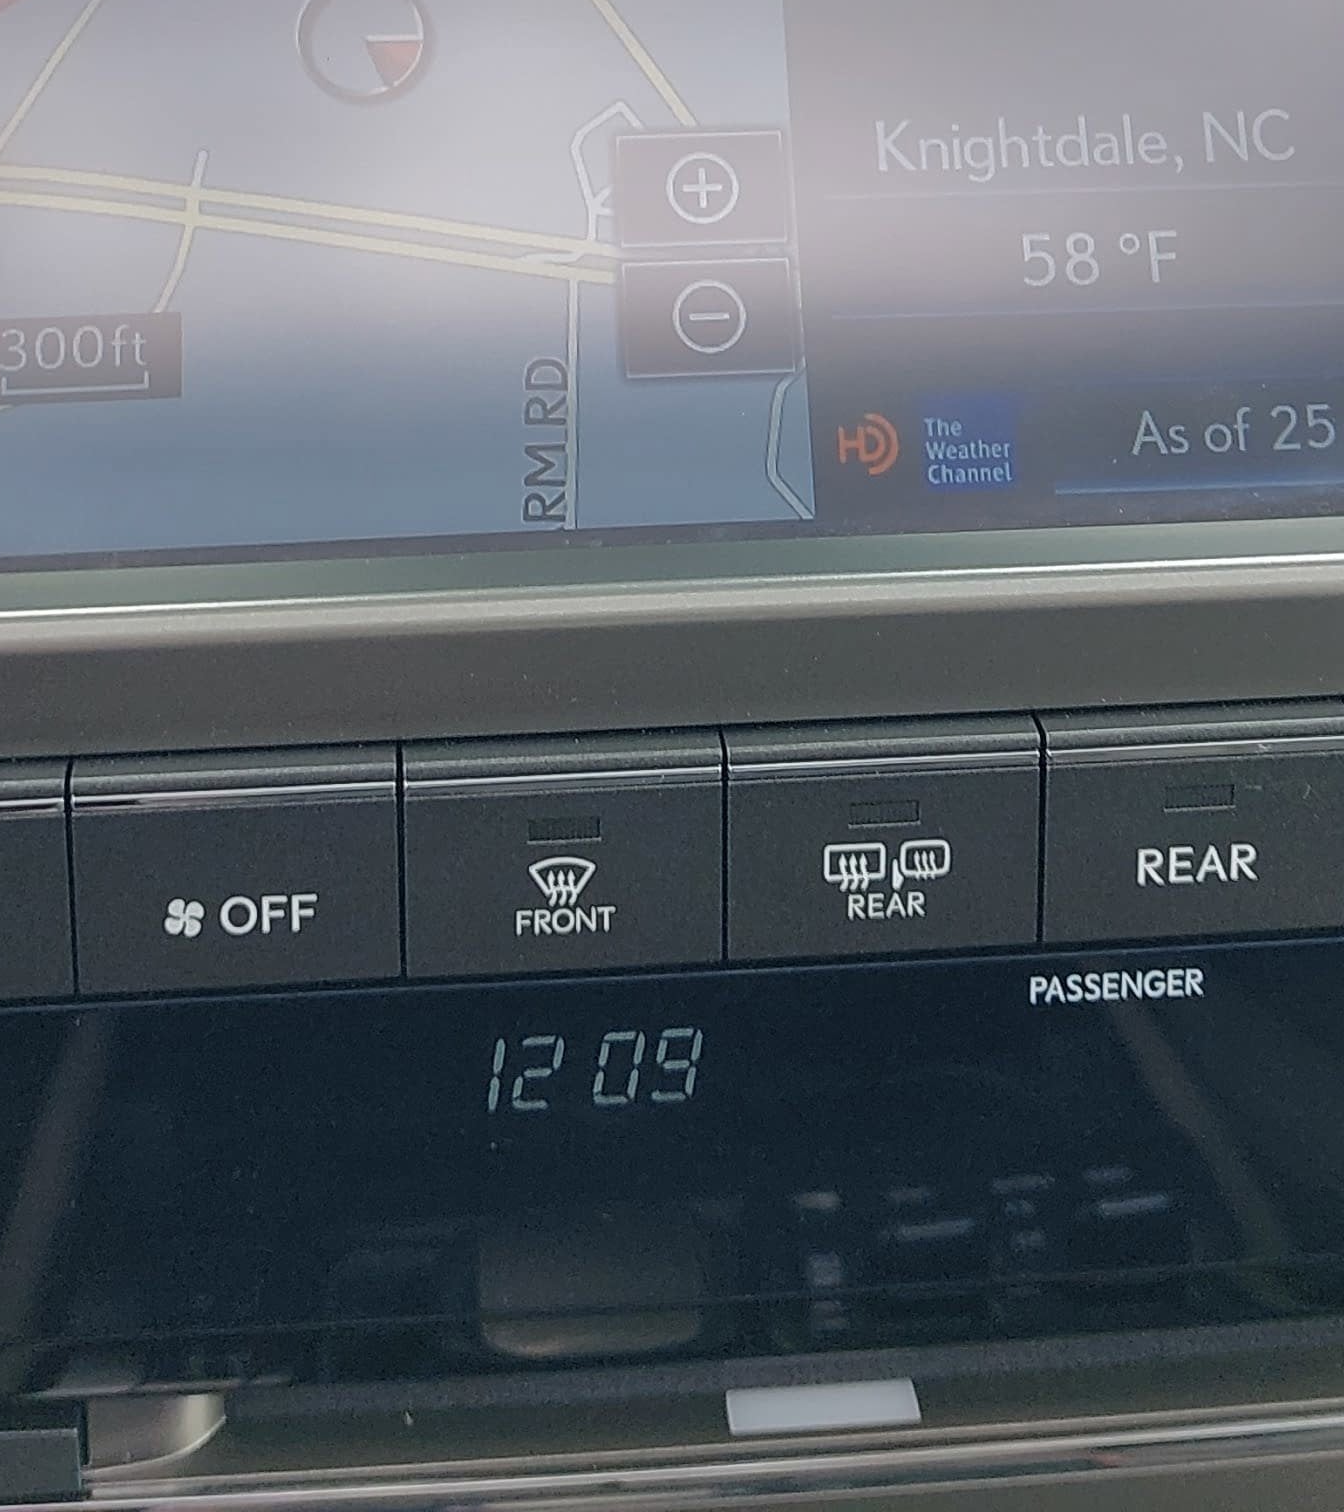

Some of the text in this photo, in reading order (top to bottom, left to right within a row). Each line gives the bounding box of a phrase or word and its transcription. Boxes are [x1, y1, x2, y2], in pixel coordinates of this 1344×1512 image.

[874, 107, 1296, 183] Knightdale, NC
[1021, 230, 1102, 288] 58
[522, 356, 569, 427] RD
[923, 416, 963, 437] The
[1131, 409, 1190, 457] As
[1204, 406, 1252, 453] of
[1271, 402, 1336, 451] 25
[924, 440, 1011, 461] Weather
[927, 461, 1013, 485] Channel
[1135, 843, 1259, 887] REAR
[218, 892, 319, 936] OFF
[515, 905, 617, 937] FRONT
[846, 891, 928, 922] REAR
[1029, 967, 1206, 1005] PASSENGER
